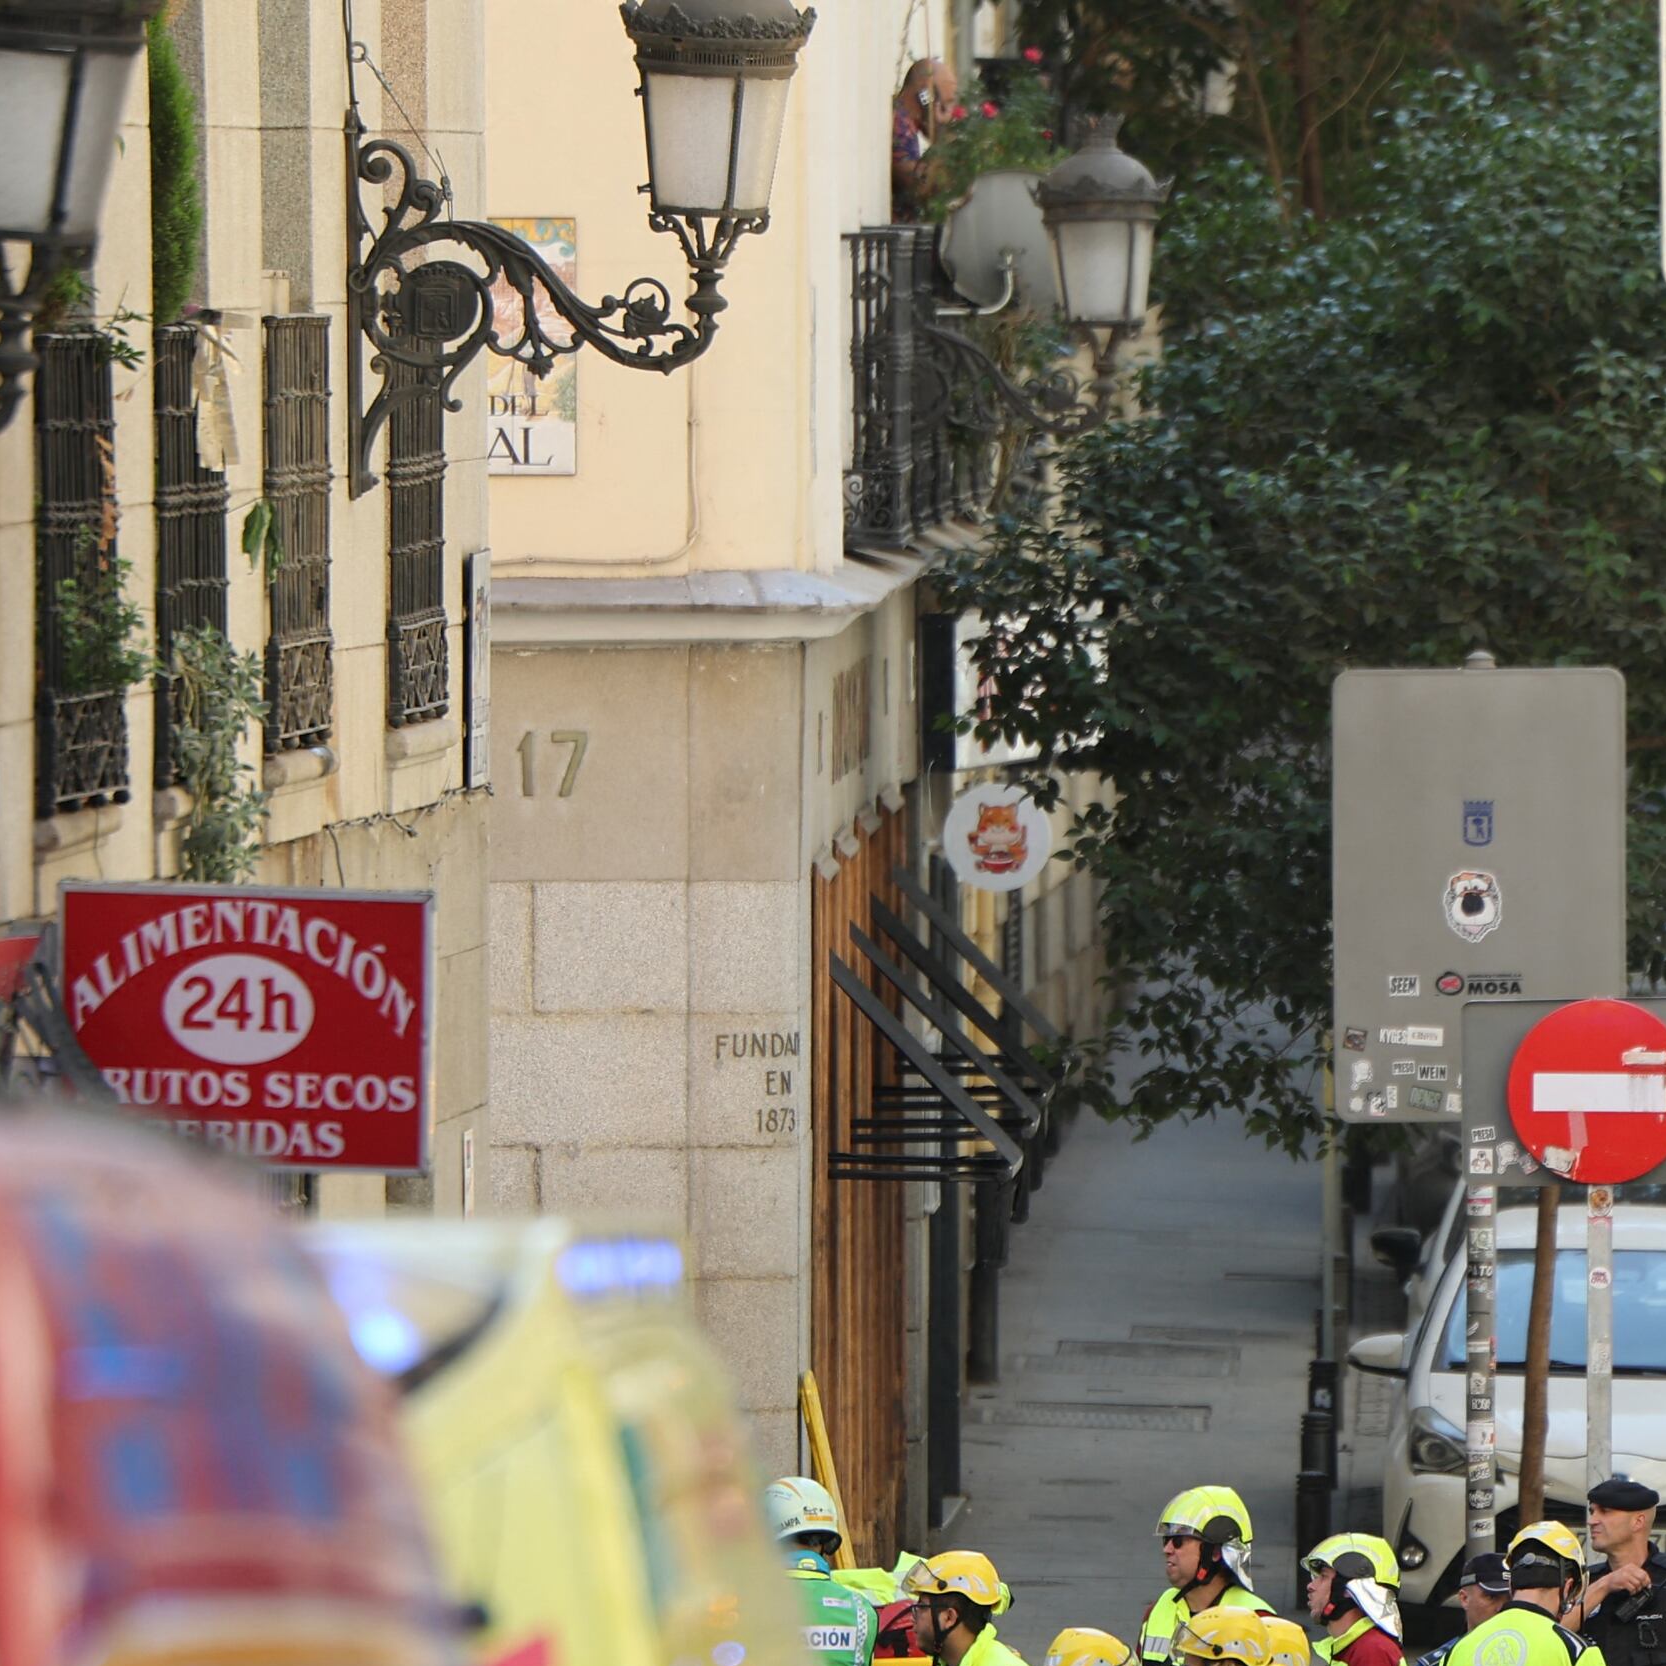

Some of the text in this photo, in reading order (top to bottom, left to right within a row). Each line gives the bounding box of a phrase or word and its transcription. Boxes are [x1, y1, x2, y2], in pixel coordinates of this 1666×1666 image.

[516, 730, 588, 798] 17
[70, 899, 416, 1039] ALIMENTACIÓN
[180, 975, 300, 1034] 24h
[1468, 981, 1522, 995] MOSA
[101, 1067, 417, 1113] RUTOS SECOS
[765, 1070, 792, 1096] EN
[1419, 1067, 1447, 1079] WEIN
[756, 1107, 797, 1133] 1873
